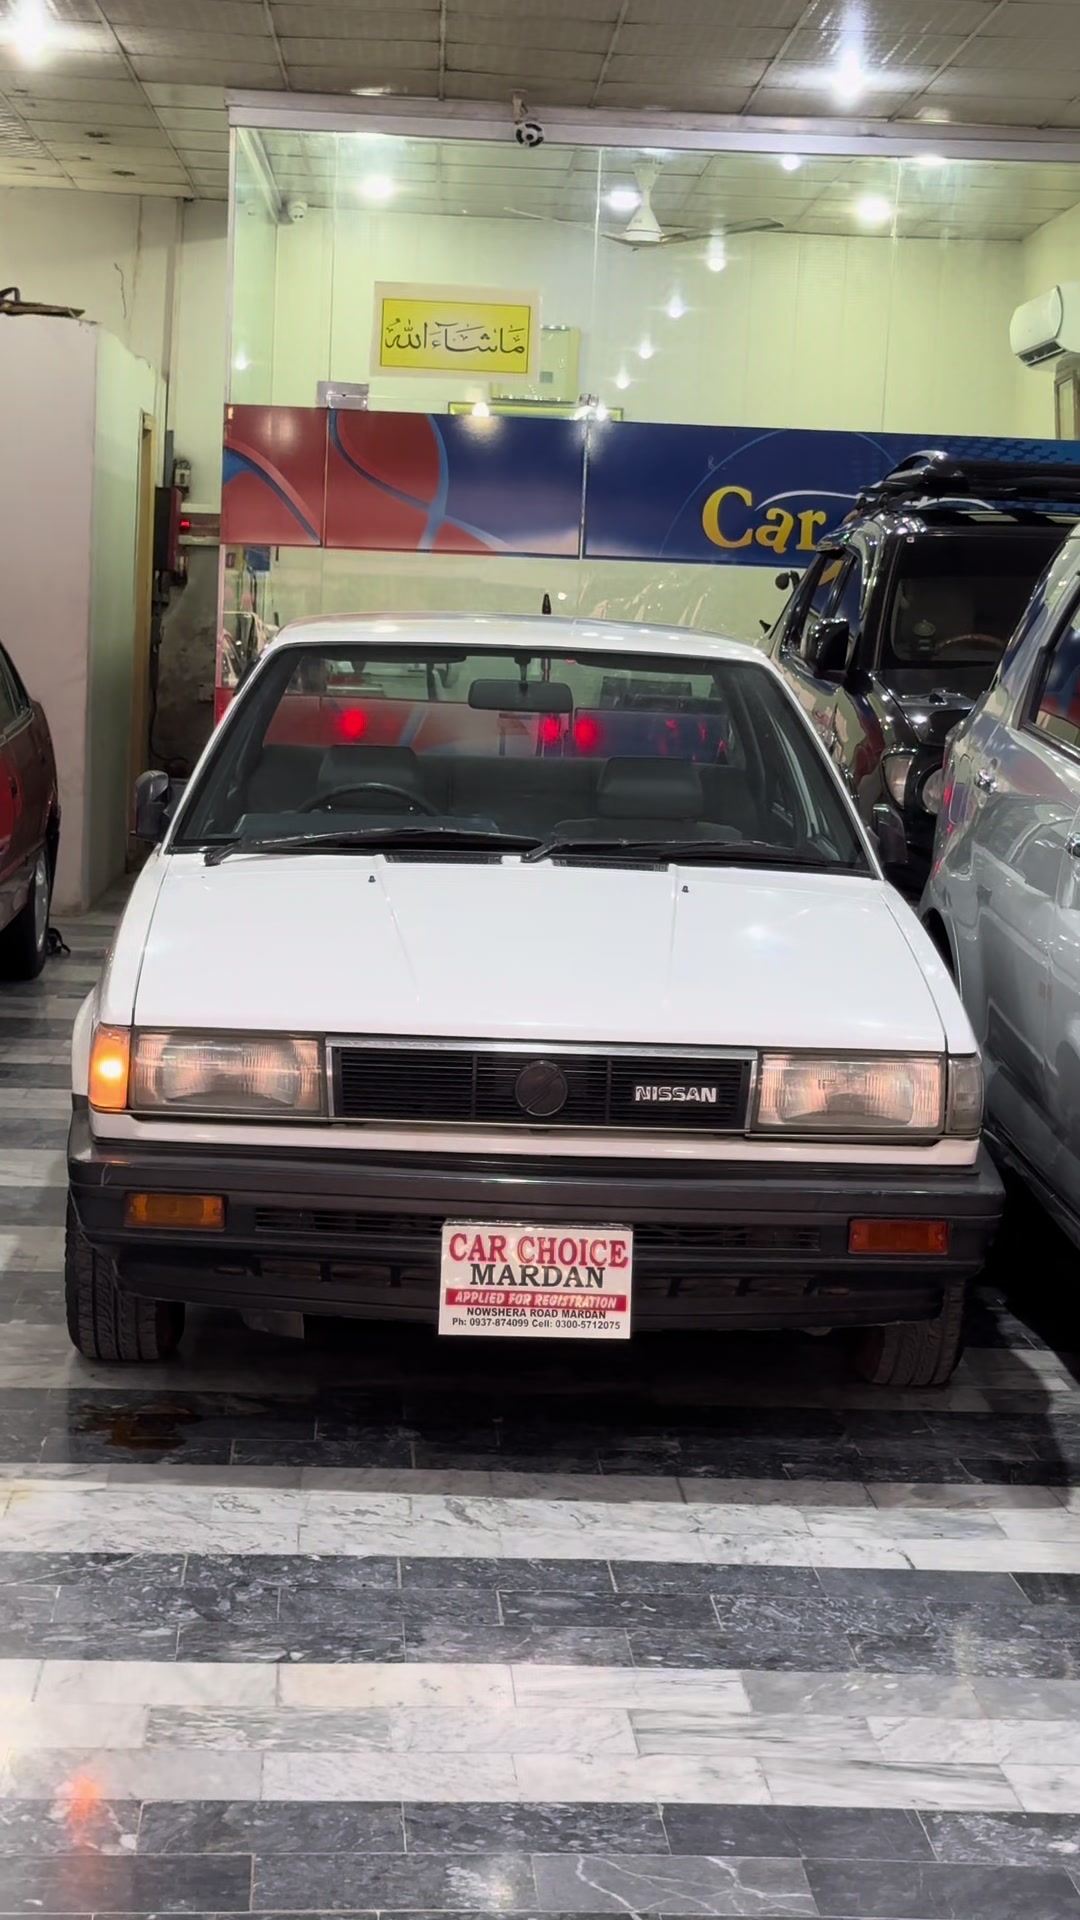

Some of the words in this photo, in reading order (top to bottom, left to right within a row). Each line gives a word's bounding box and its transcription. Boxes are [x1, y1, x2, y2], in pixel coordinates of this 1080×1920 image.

[702, 485, 827, 554] Car
[635, 1086, 717, 1103] NISSAN
[449, 1232, 507, 1263] CAR
[517, 1235, 629, 1269] CHOICE
[469, 1263, 606, 1288] MARDAN
[454, 1290, 504, 1305] APPLIED
[508, 1292, 531, 1306] FOR
[533, 1293, 617, 1310] REGISTRATION
[466, 1307, 527, 1318] NOWSHERA
[529, 1308, 559, 1319] ROAD
[561, 1309, 606, 1319] MARDAN
[452, 1317, 467, 1327] Ph:
[469, 1318, 529, 1328] 0937-874099
[531, 1319, 553, 1328] Cell:
[555, 1319, 621, 1330] 0300-5712075
